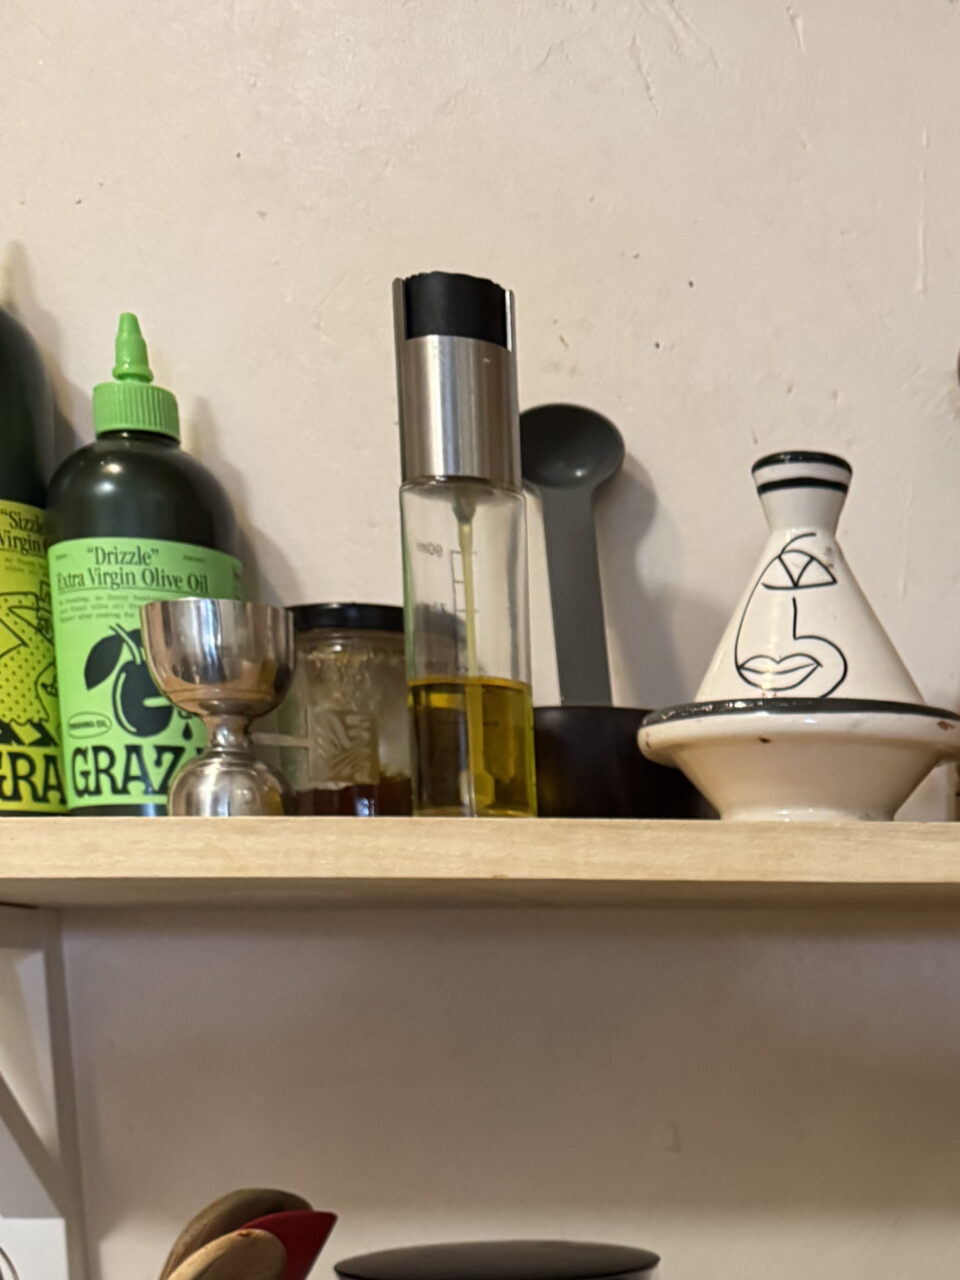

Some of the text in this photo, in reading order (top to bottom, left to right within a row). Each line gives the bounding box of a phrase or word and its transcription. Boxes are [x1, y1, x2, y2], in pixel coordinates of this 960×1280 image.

[87, 545, 159, 566] “Drizzle”
[57, 567, 209, 593] Extra Virgin Olive Oil
[72, 745, 205, 798] GRAZ
